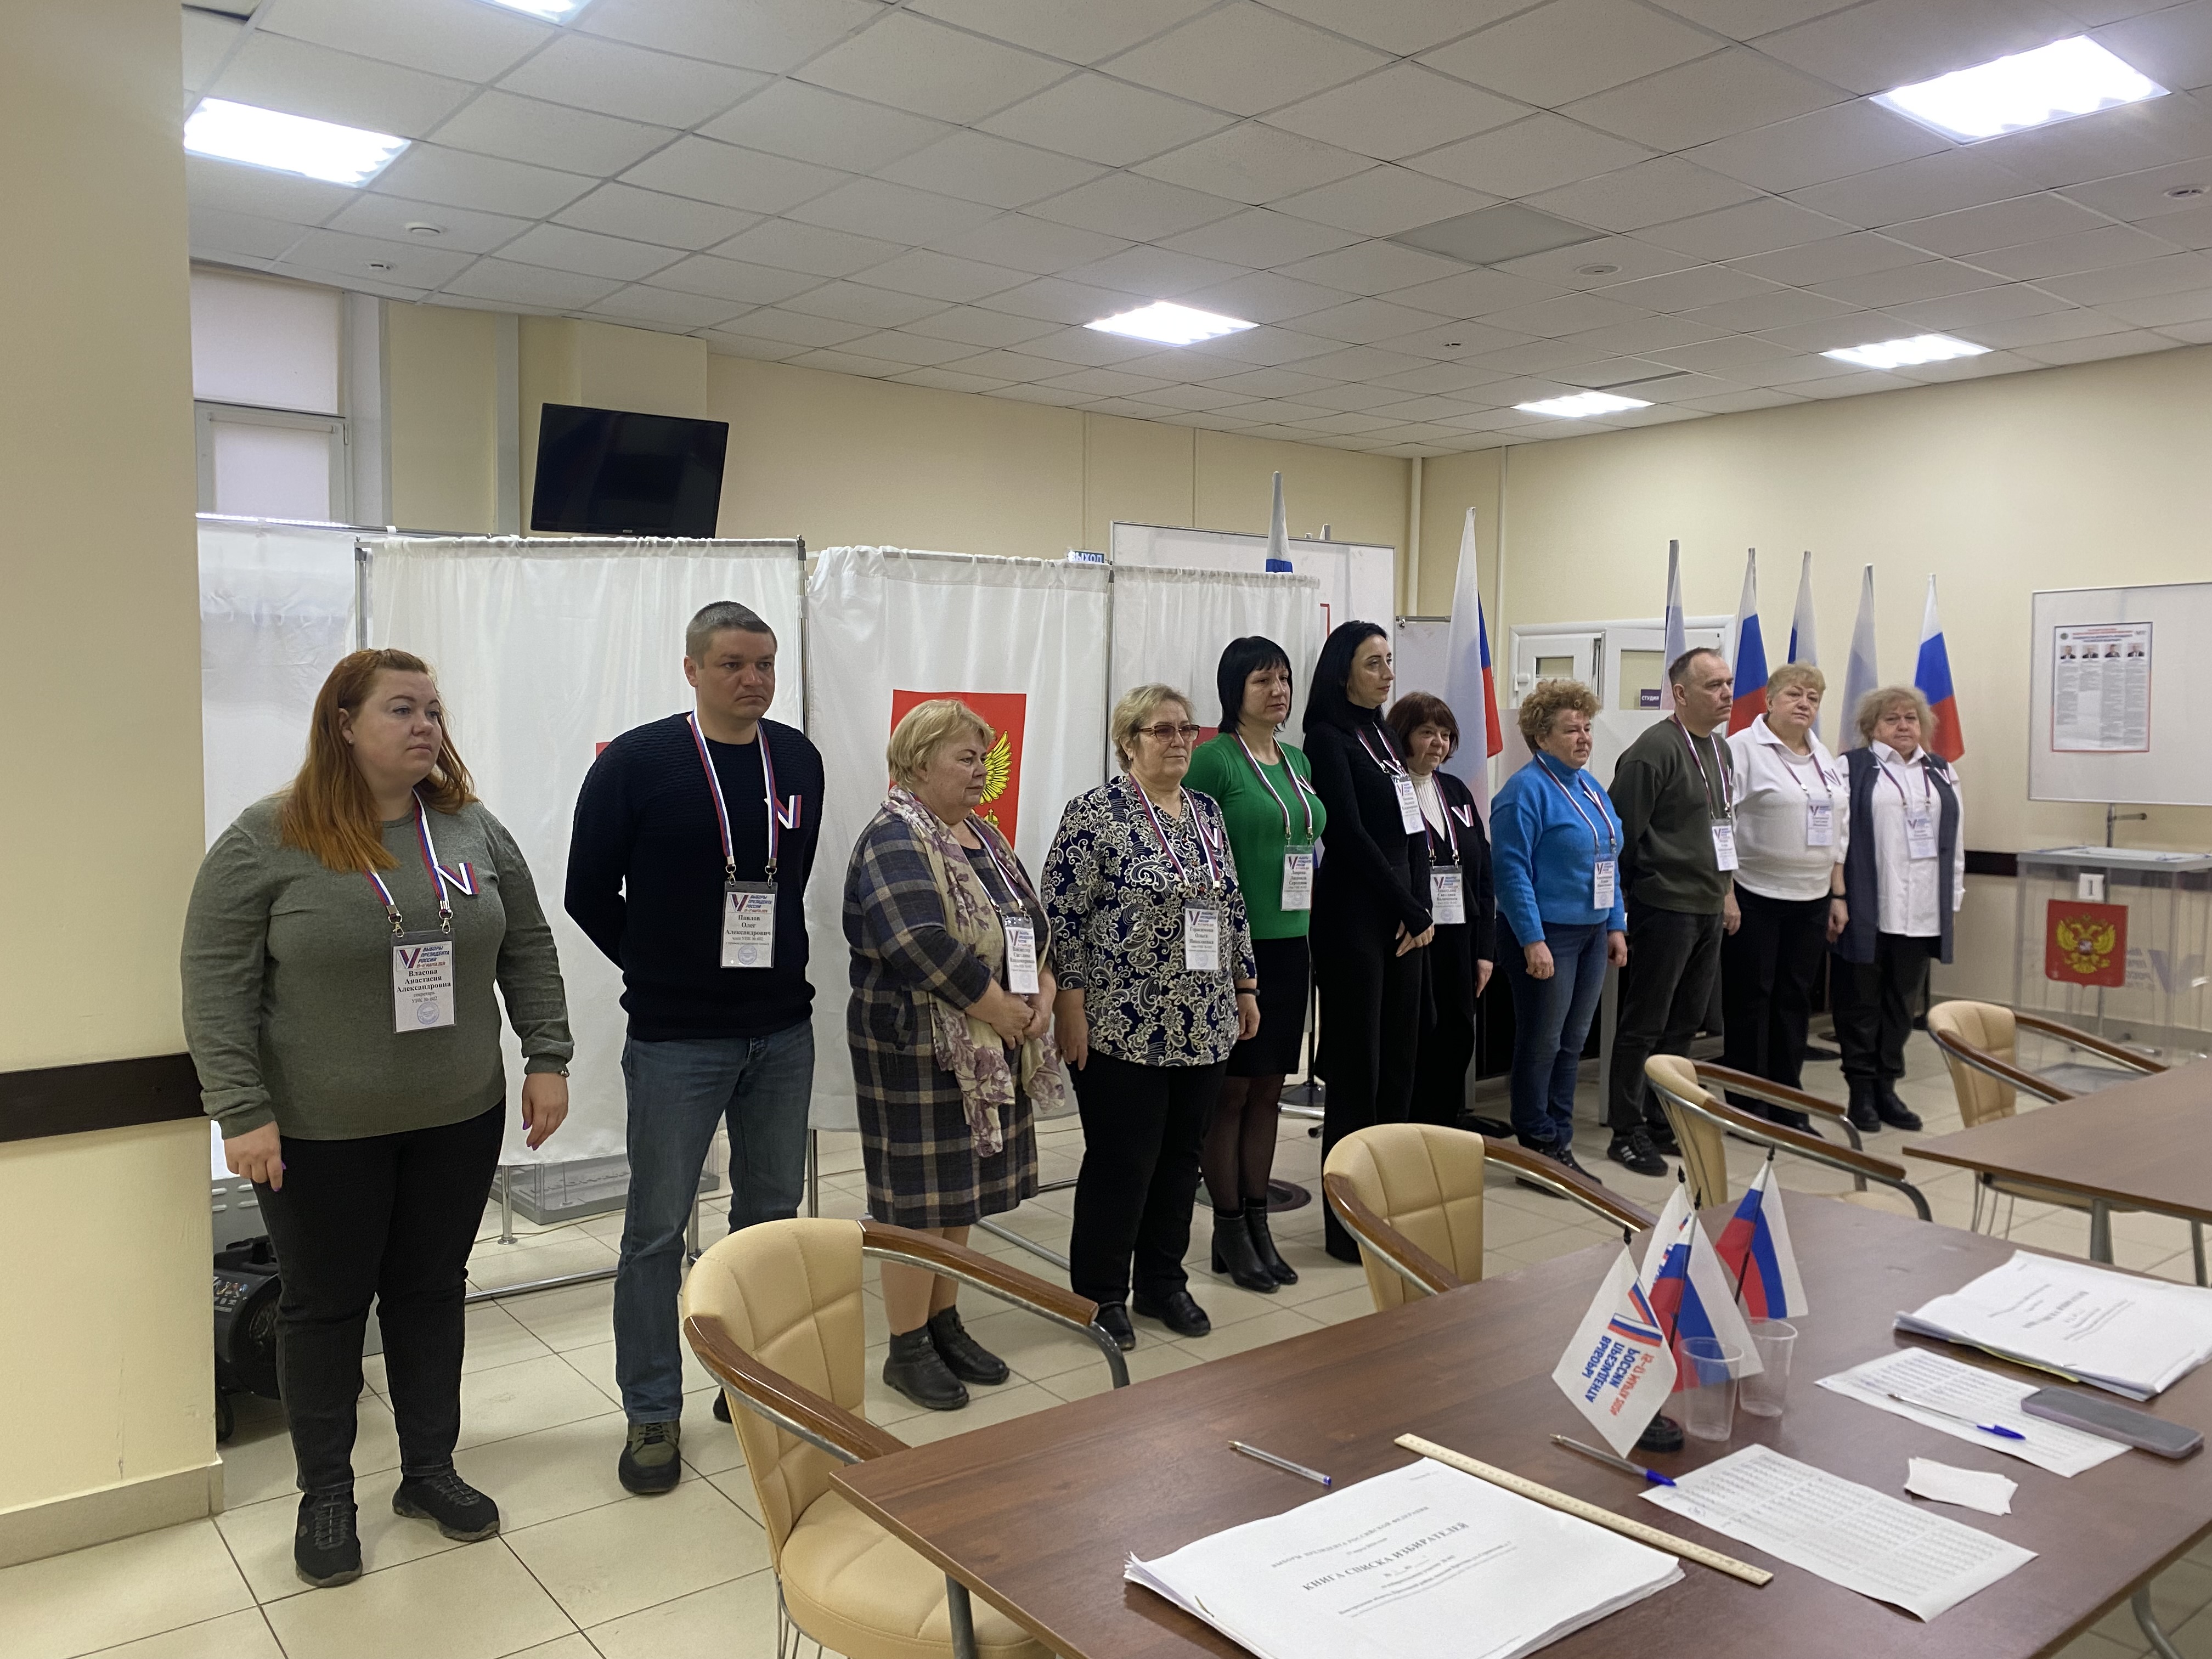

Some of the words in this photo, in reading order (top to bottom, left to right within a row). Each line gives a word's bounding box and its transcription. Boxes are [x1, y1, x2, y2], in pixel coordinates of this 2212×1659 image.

[404, 976, 442, 984] Анастасия
[396, 982, 452, 992] Александровна
[1302, 1572, 1346, 1591] КНИГА
[1345, 1556, 1394, 1575] СПИСКА
[1391, 1521, 1469, 1559] ИЗБИРАТЕЛЕЙ
